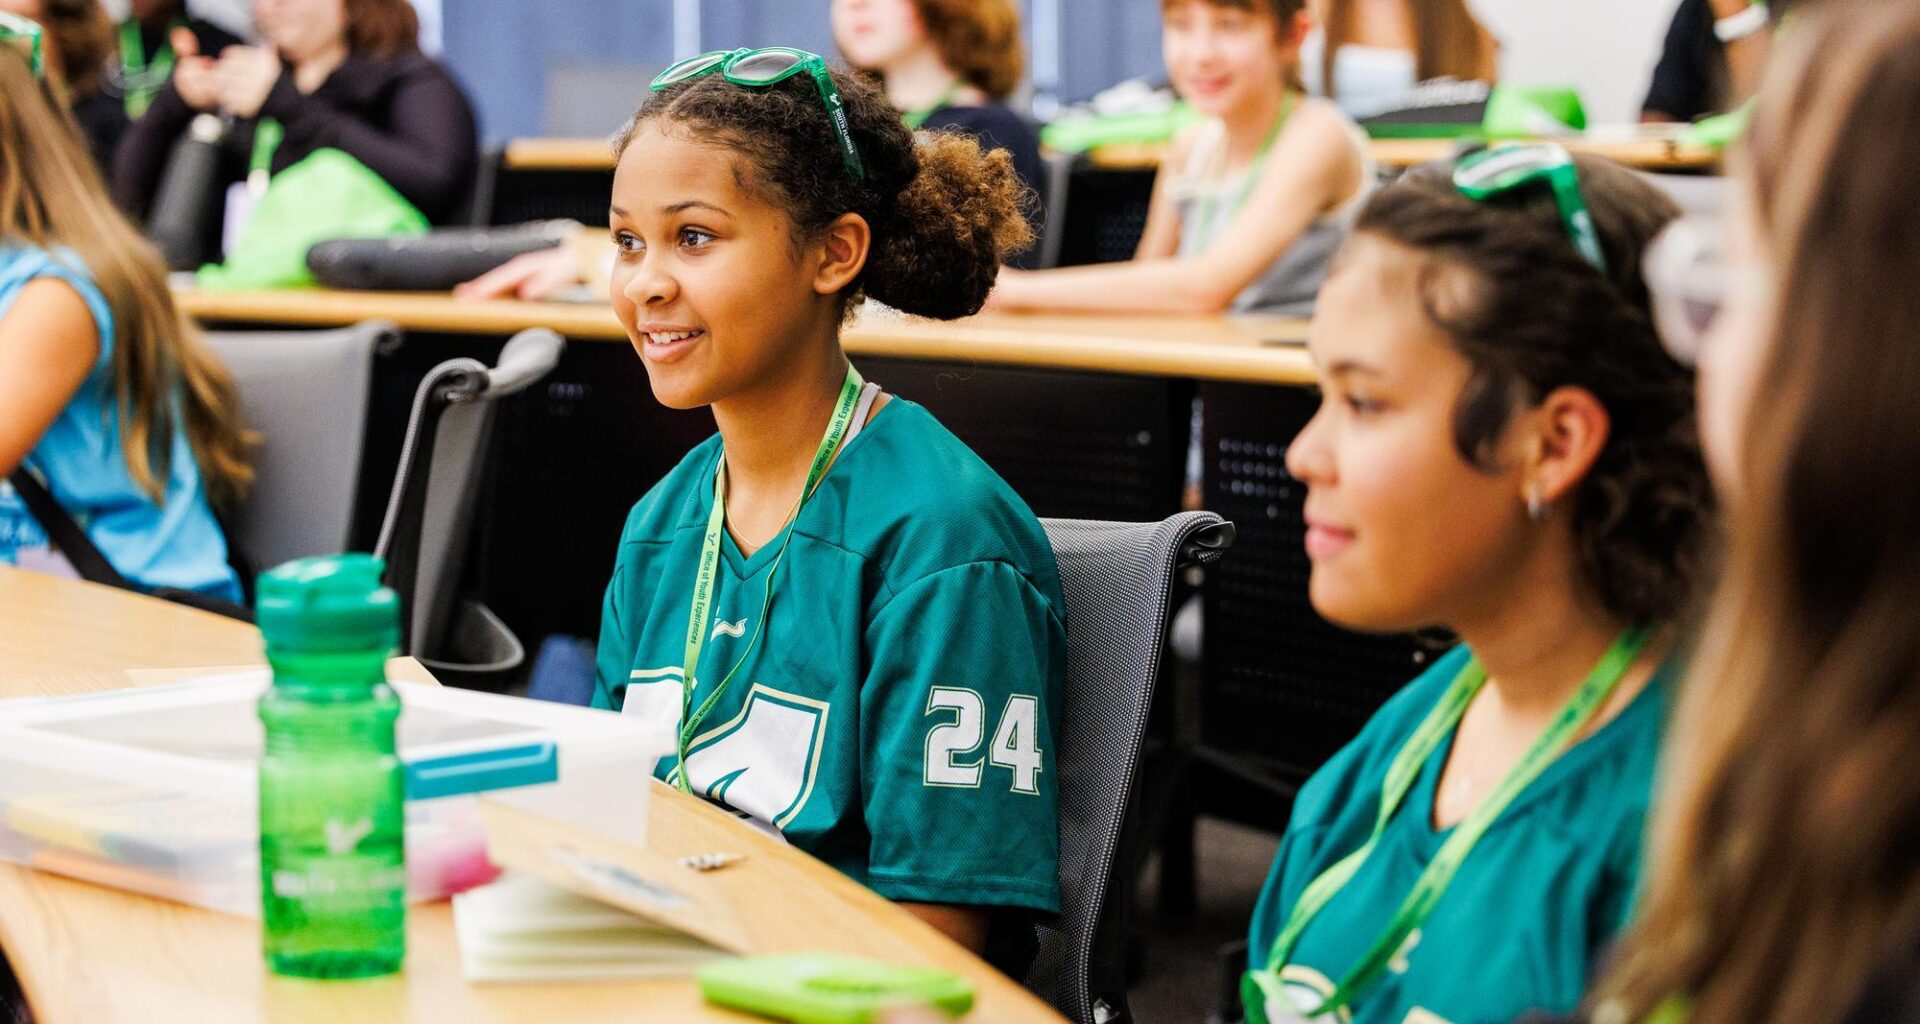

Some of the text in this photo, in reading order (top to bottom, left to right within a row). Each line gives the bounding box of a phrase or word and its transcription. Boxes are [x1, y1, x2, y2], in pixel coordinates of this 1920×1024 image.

[835, 108, 846, 130] SOUTH
[842, 129, 854, 155] FLORIDA
[828, 439, 836, 450] of
[829, 420, 845, 441] Youth
[815, 448, 831, 471] Office
[690, 551, 714, 645] Office of Youth Experiences
[923, 685, 1043, 796] 24
